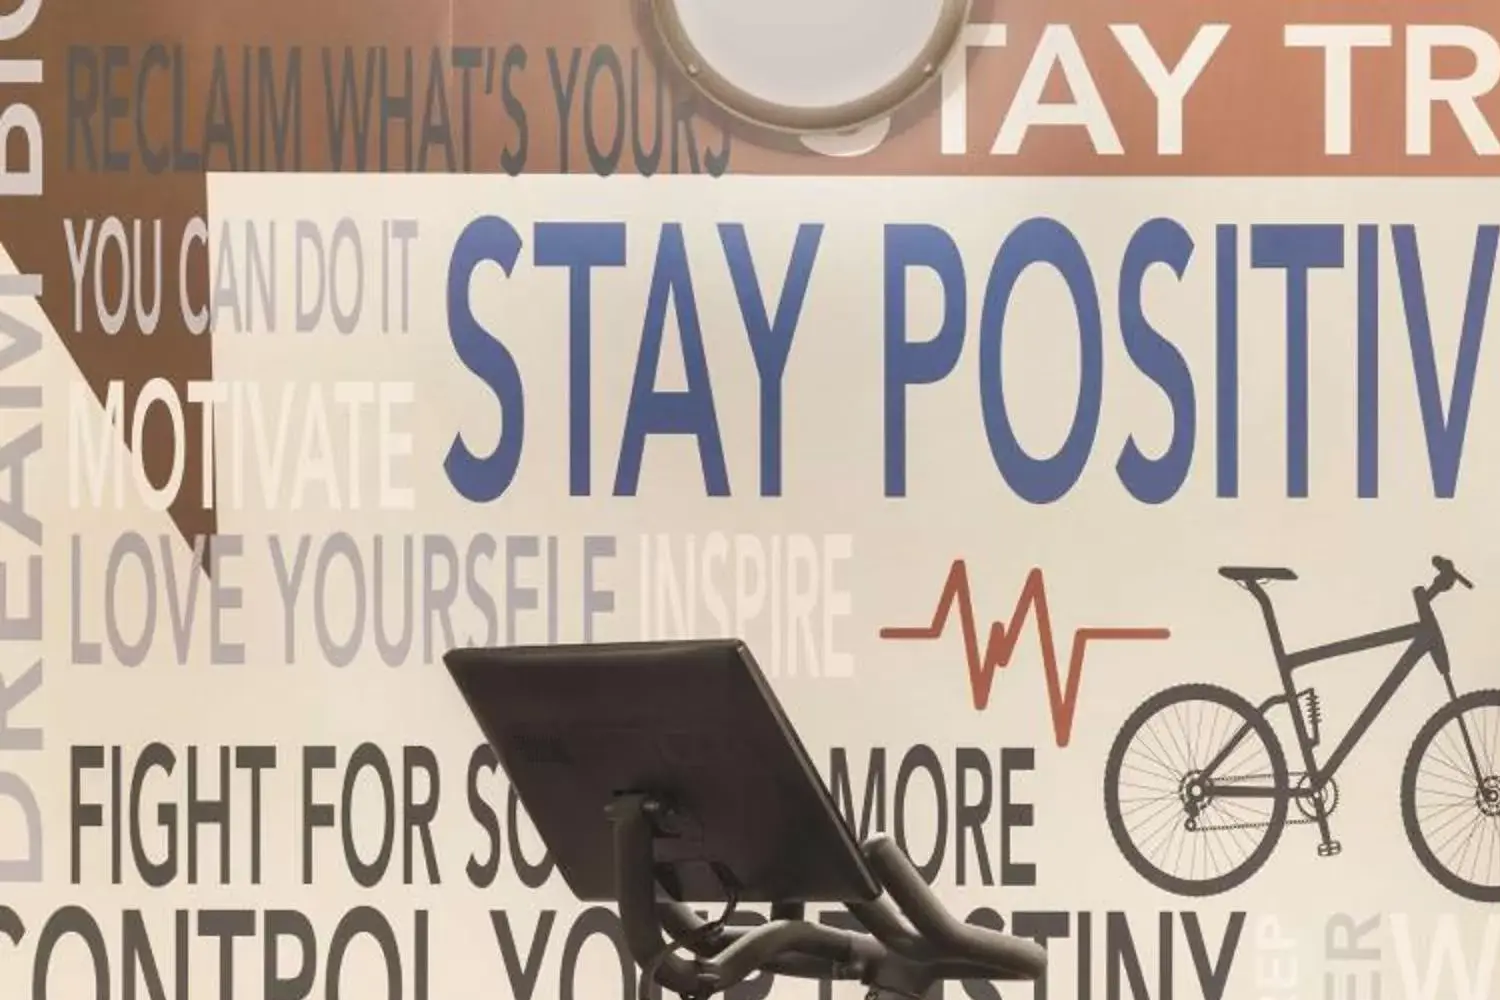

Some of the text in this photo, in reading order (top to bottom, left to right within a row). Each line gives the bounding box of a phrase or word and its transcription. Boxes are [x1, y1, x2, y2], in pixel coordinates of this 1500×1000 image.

[65, 44, 302, 175] RECLAIM
[321, 44, 529, 177] WHAT'S
[800, 24, 1231, 157] TAY
[63, 216, 418, 336] YOU CAN DO IT
[443, 215, 825, 503] STAY
[67, 377, 415, 511] MOTIVATE
[71, 531, 245, 667] LOVE
[70, 742, 277, 888] FIGHT
[302, 742, 441, 888] FOR
